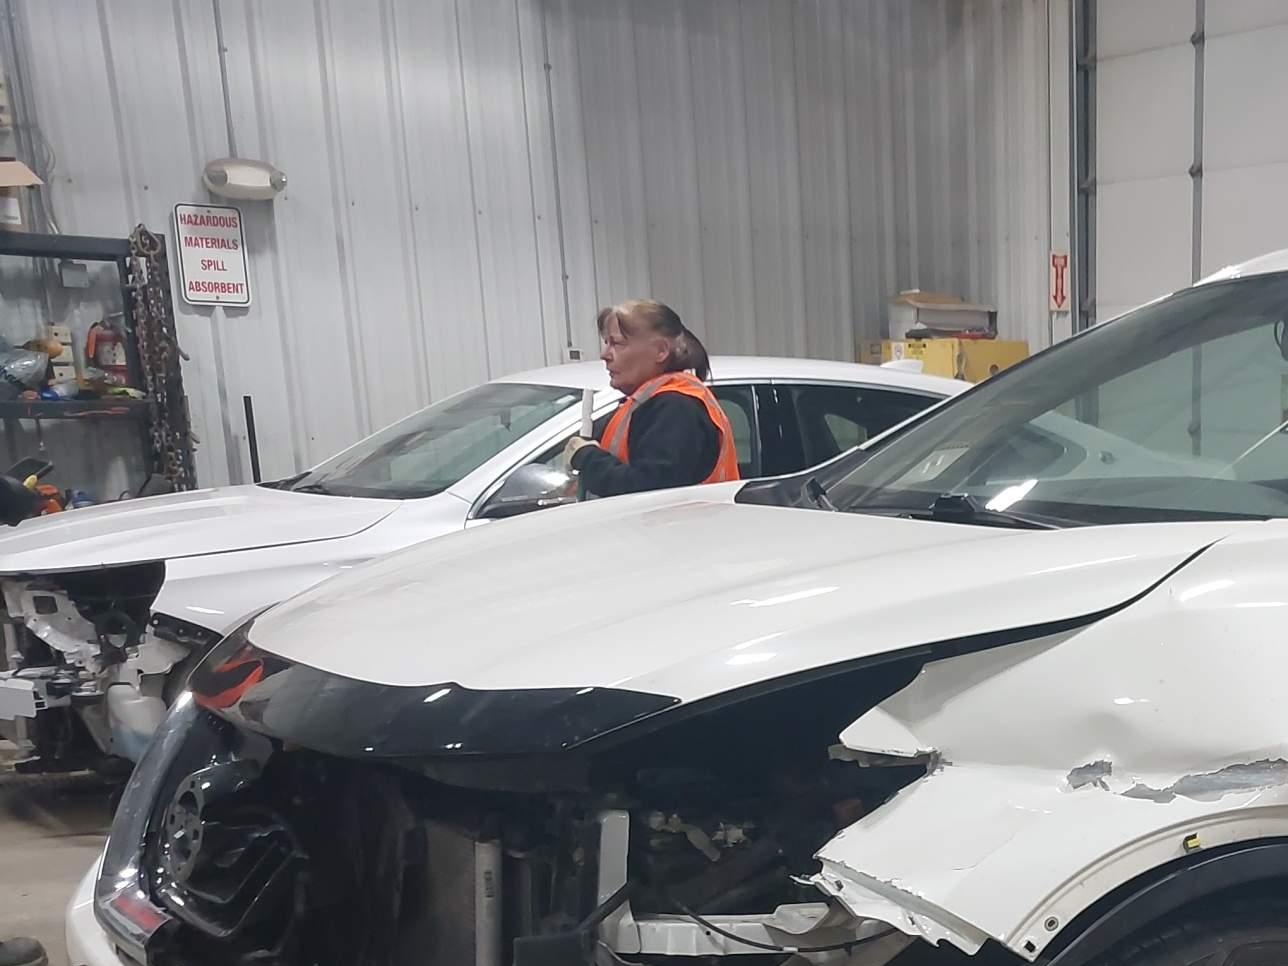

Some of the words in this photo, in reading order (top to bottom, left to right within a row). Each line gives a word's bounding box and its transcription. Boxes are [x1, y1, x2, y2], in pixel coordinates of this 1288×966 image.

[180, 213, 238, 228] HAZARDOUS
[184, 236, 239, 250] MATERIALS
[201, 259, 227, 271] SPILL
[188, 281, 244, 294] ABSORBENT
